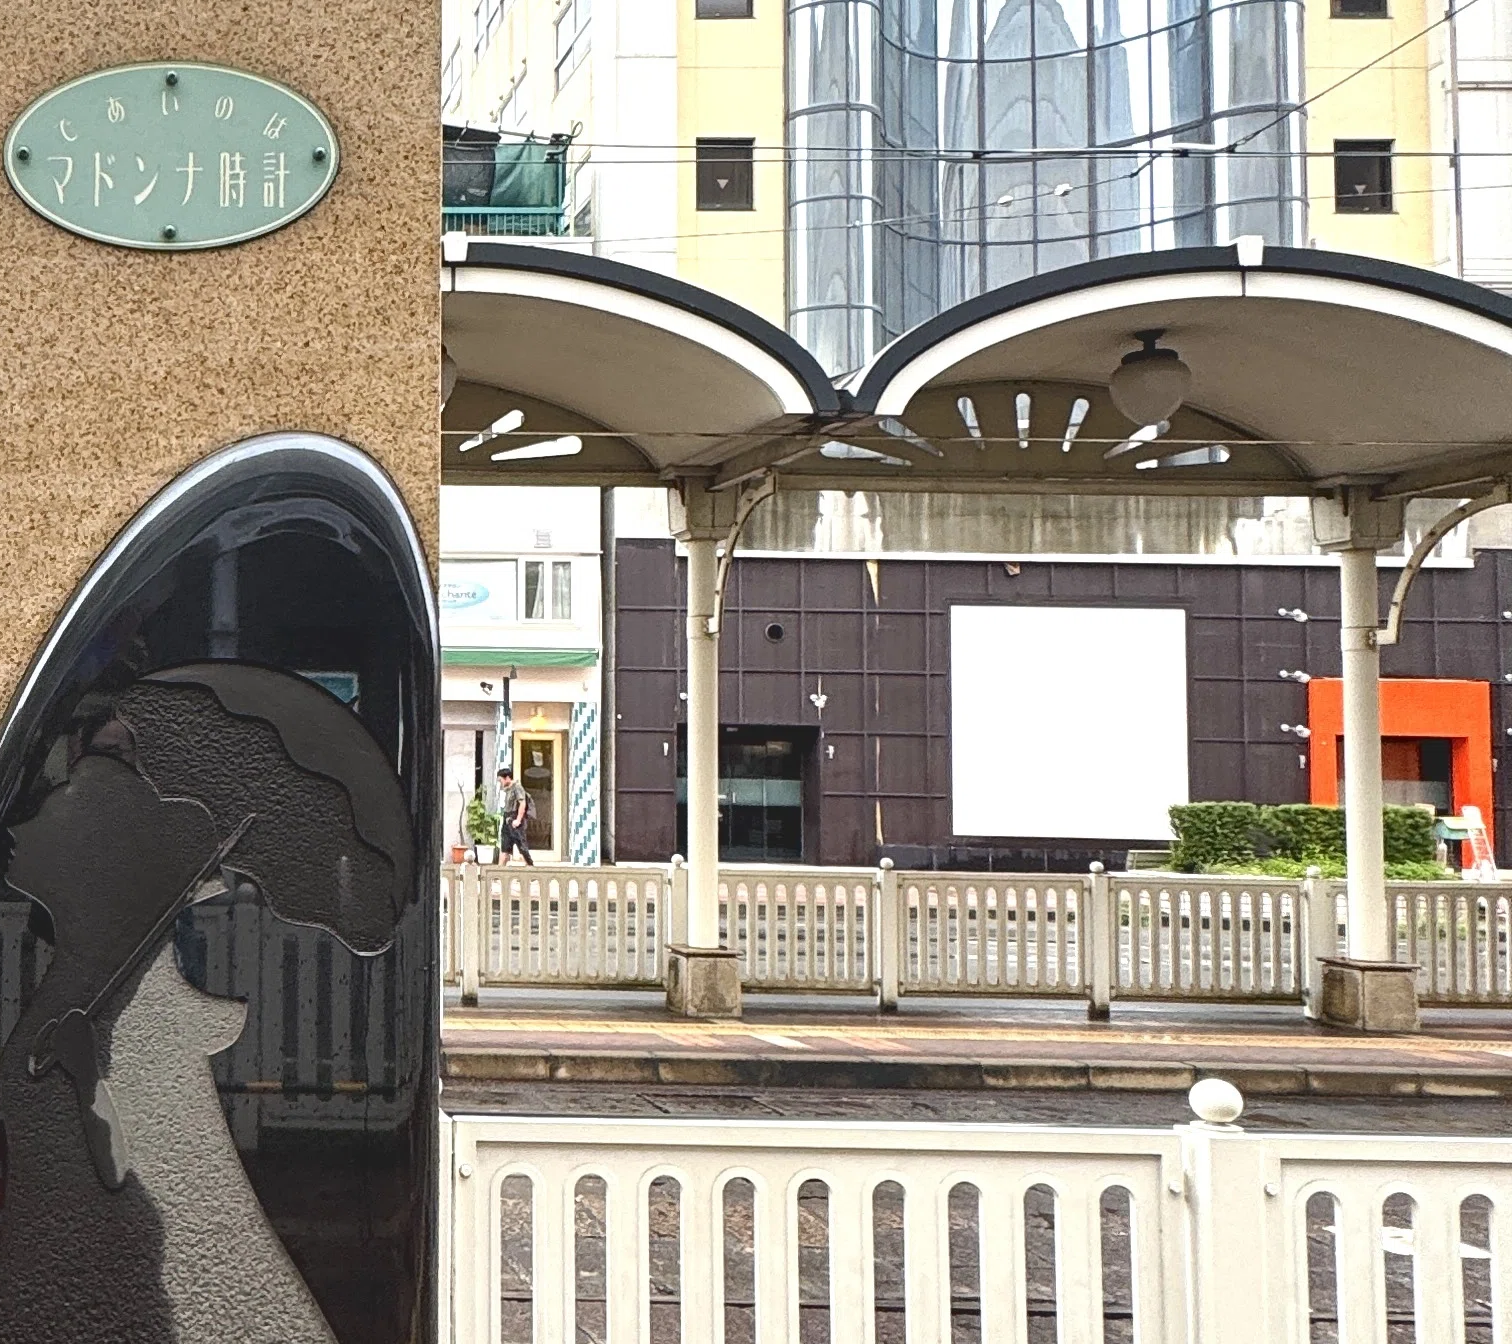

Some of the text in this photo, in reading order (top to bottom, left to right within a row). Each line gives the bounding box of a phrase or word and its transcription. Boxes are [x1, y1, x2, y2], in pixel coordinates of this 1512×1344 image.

[47, 152, 290, 208] マドンナ時計
